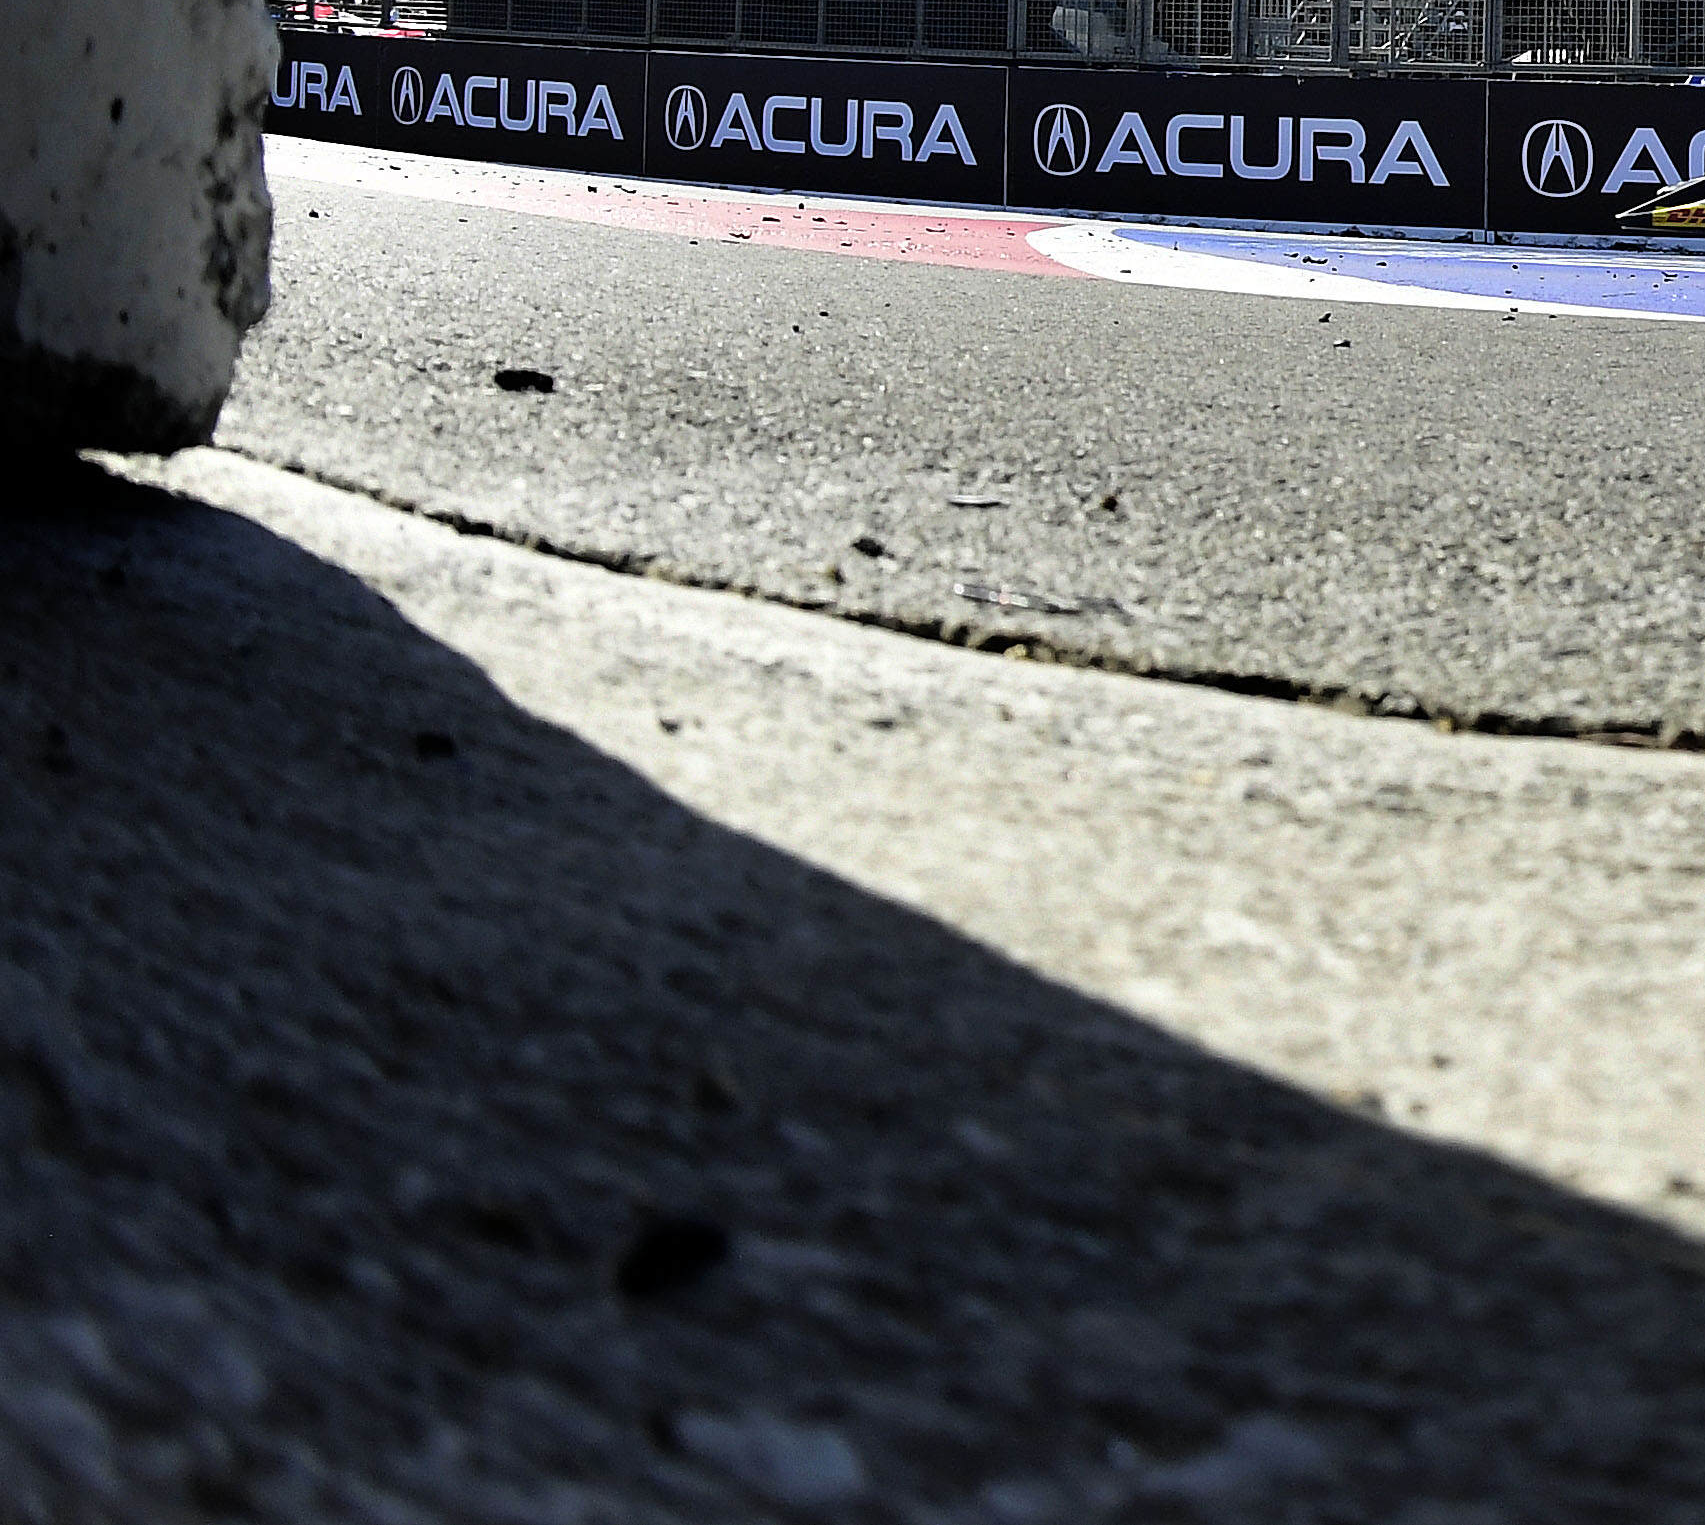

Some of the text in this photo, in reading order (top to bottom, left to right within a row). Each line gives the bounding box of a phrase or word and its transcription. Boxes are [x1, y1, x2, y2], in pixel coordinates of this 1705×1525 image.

[270, 60, 362, 115] URA
[425, 74, 623, 140] ACURA
[710, 93, 977, 165] ACURA
[1096, 112, 1450, 186] ACURA
